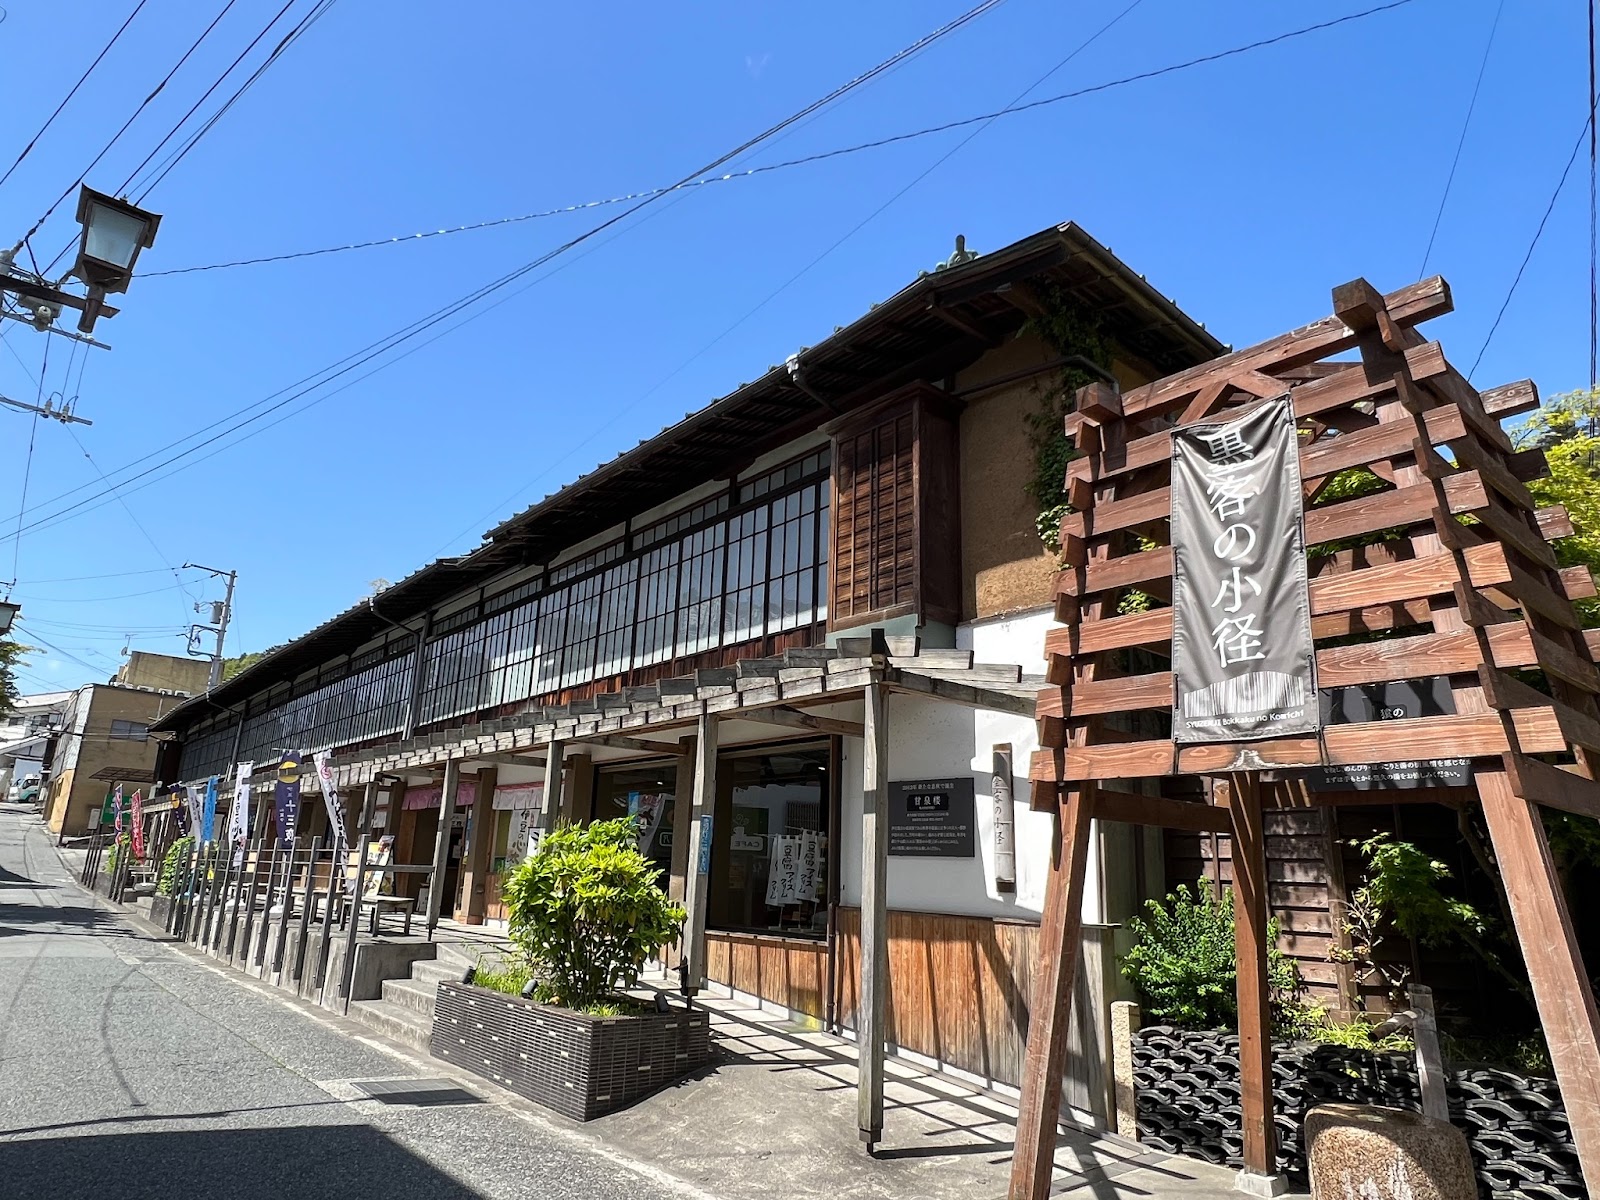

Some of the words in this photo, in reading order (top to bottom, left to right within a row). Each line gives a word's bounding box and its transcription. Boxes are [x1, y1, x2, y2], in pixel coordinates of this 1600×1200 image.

[1222, 716, 1256, 727] Bokkaku
[1256, 714, 1268, 722] no
[506, 810, 530, 865] 伊豆の心太
